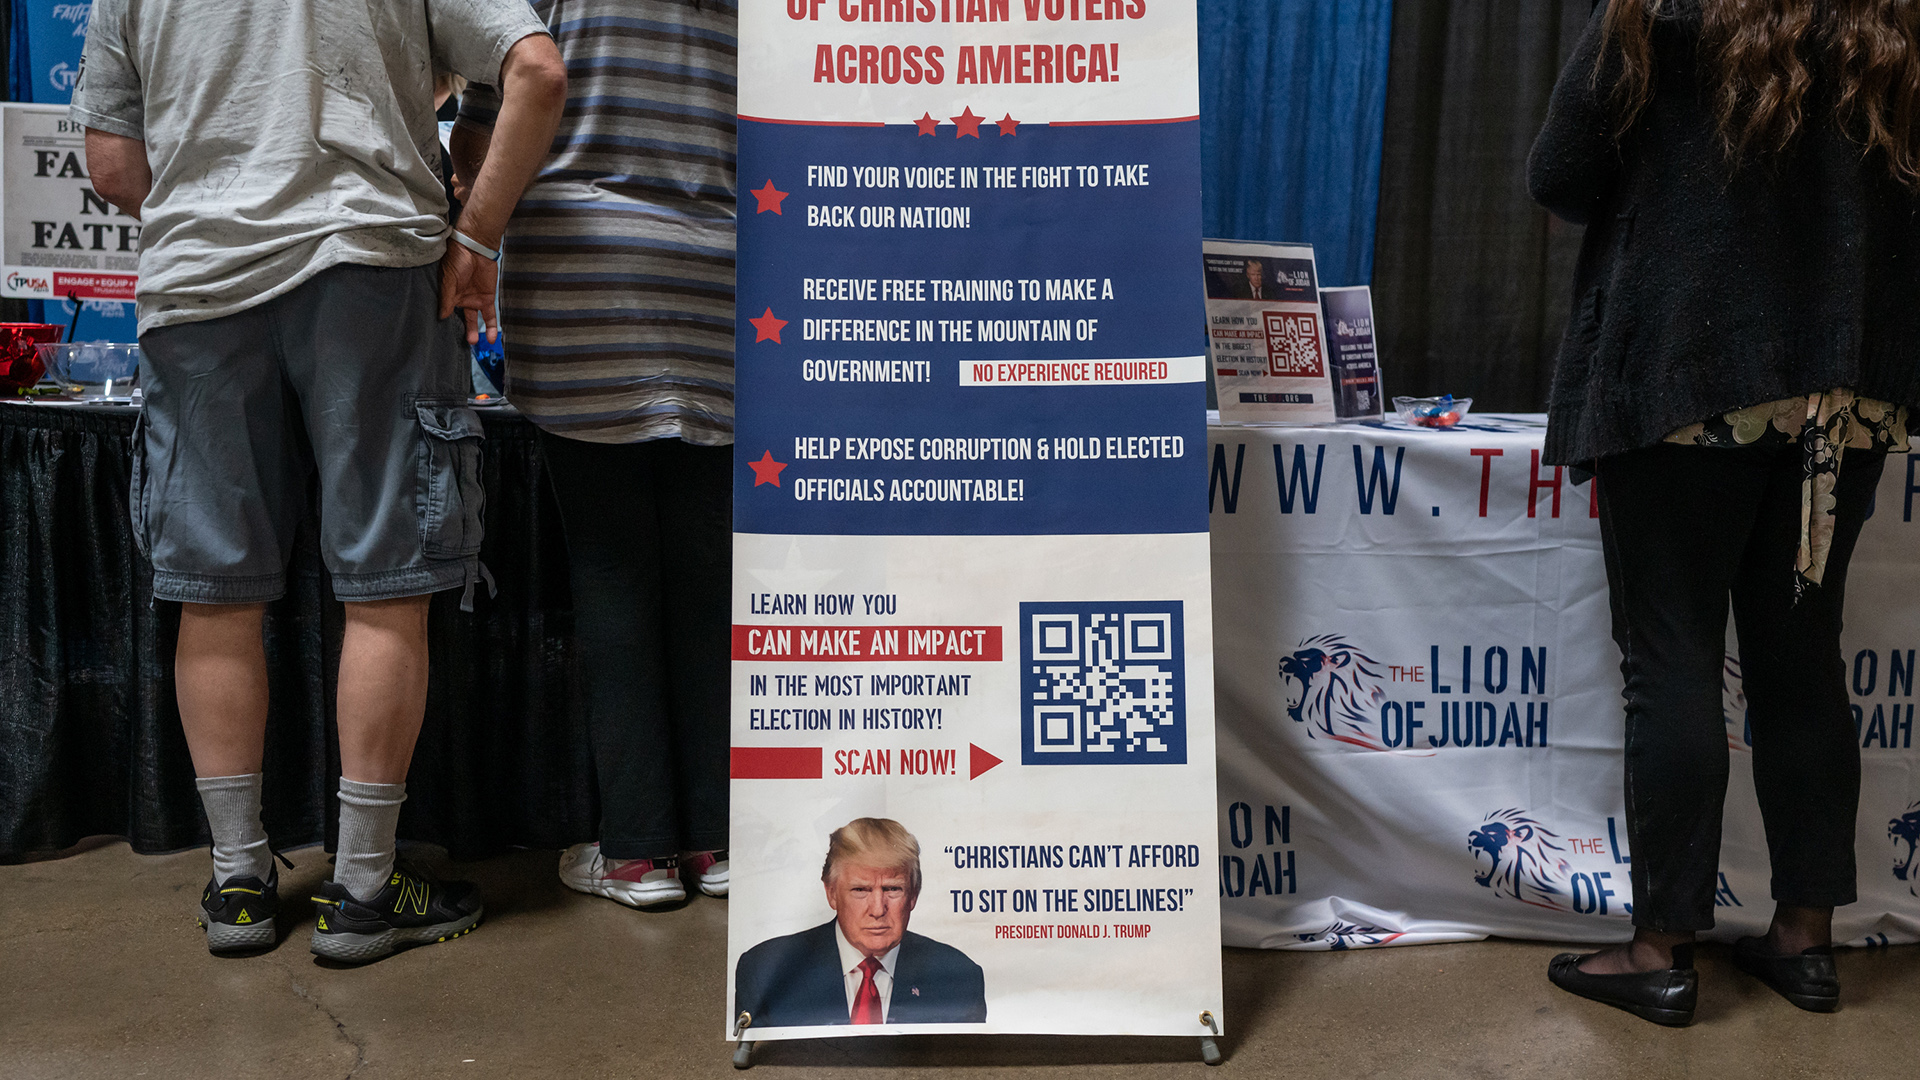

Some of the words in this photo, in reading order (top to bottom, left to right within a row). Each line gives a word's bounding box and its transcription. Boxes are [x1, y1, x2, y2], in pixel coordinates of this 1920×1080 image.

[838, 0, 1010, 23] CHRISTIAN
[1024, 0, 1147, 21] VOTERS
[813, 44, 945, 84] ACROSS
[956, 43, 1120, 84] AMERICA!
[807, 166, 848, 187] FIND
[853, 166, 900, 188] YOUR
[904, 167, 955, 189] VOICE
[960, 167, 978, 188] IN
[983, 167, 1017, 188] THE
[1022, 166, 1071, 188] FIGHT
[1075, 165, 1099, 187] TO
[1102, 164, 1149, 186] TAKE
[807, 206, 855, 228] BACK
[860, 206, 895, 228] OUR
[900, 207, 970, 228] NATION!
[14, 277, 48, 289] TPUSA
[58, 277, 95, 286] ENGAGE
[101, 278, 129, 288] EQUIP
[803, 279, 877, 300] RECEIVE
[882, 279, 926, 301] FREE
[931, 280, 1013, 301] TRAINING
[1018, 280, 1040, 301] TO
[1045, 279, 1097, 300] MAKE
[1101, 278, 1114, 300] A
[803, 319, 910, 342] DIFFERENCE
[916, 320, 934, 341] IN
[939, 320, 972, 342] THE
[978, 320, 1071, 342] MOUNTAIN
[1076, 319, 1098, 341] OF
[1212, 316, 1229, 325] LEARN
[1231, 317, 1244, 325] HOW
[1246, 317, 1257, 325] YOU
[1224, 330, 1238, 338] MAKE
[1216, 355, 1239, 363] ELECTION
[803, 359, 931, 383] GOVERNMENT!
[973, 363, 994, 382] NO
[998, 363, 1090, 382] EXPERIENCE
[1094, 361, 1168, 382] REQUIRED
[795, 437, 841, 459] HELP
[845, 438, 915, 460] EXPOSE
[919, 438, 1033, 460] CORRUPTION
[1037, 438, 1049, 460] &
[1054, 437, 1101, 459] HOLD
[1106, 436, 1184, 459] ELECTED
[795, 478, 885, 502] OFFICIALS
[889, 479, 1024, 502] ACCOUNTABLE!
[751, 593, 807, 615] LEARN
[814, 594, 857, 615] HOW
[862, 594, 897, 615] YOU
[748, 629, 791, 655] CAN
[800, 630, 861, 656] MAKE
[869, 630, 899, 655] AN
[907, 630, 986, 656] IMPACT
[1388, 665, 1425, 682] THE
[1430, 645, 1547, 694] LION
[750, 675, 767, 696] IN
[774, 675, 807, 696] THE
[814, 675, 864, 696] MOST
[870, 675, 971, 696] IMPORTANT
[750, 708, 831, 731] ELECTION
[839, 708, 856, 731] IN
[862, 708, 942, 731] HISTORY!
[1381, 701, 1425, 748] OF
[1429, 701, 1548, 748] JUDAH
[834, 749, 891, 775] SCAN
[901, 748, 956, 775] NOW!
[944, 845, 1063, 869] “CHRISTIANS
[1069, 845, 1124, 868] CAN’T
[1128, 844, 1200, 868] AFFORD
[1568, 838, 1605, 855] THE
[950, 889, 973, 913] TO
[979, 889, 1006, 913] SIT
[1012, 889, 1038, 913] ON
[1043, 889, 1078, 912] THE
[1083, 888, 1194, 912] SIDELINES!”
[1570, 872, 1621, 915] OF
[995, 925, 1055, 940] PRESIDENT
[1057, 925, 1100, 939] DONALD
[1102, 925, 1112, 939] J.
[1114, 924, 1151, 939] TRUMP
